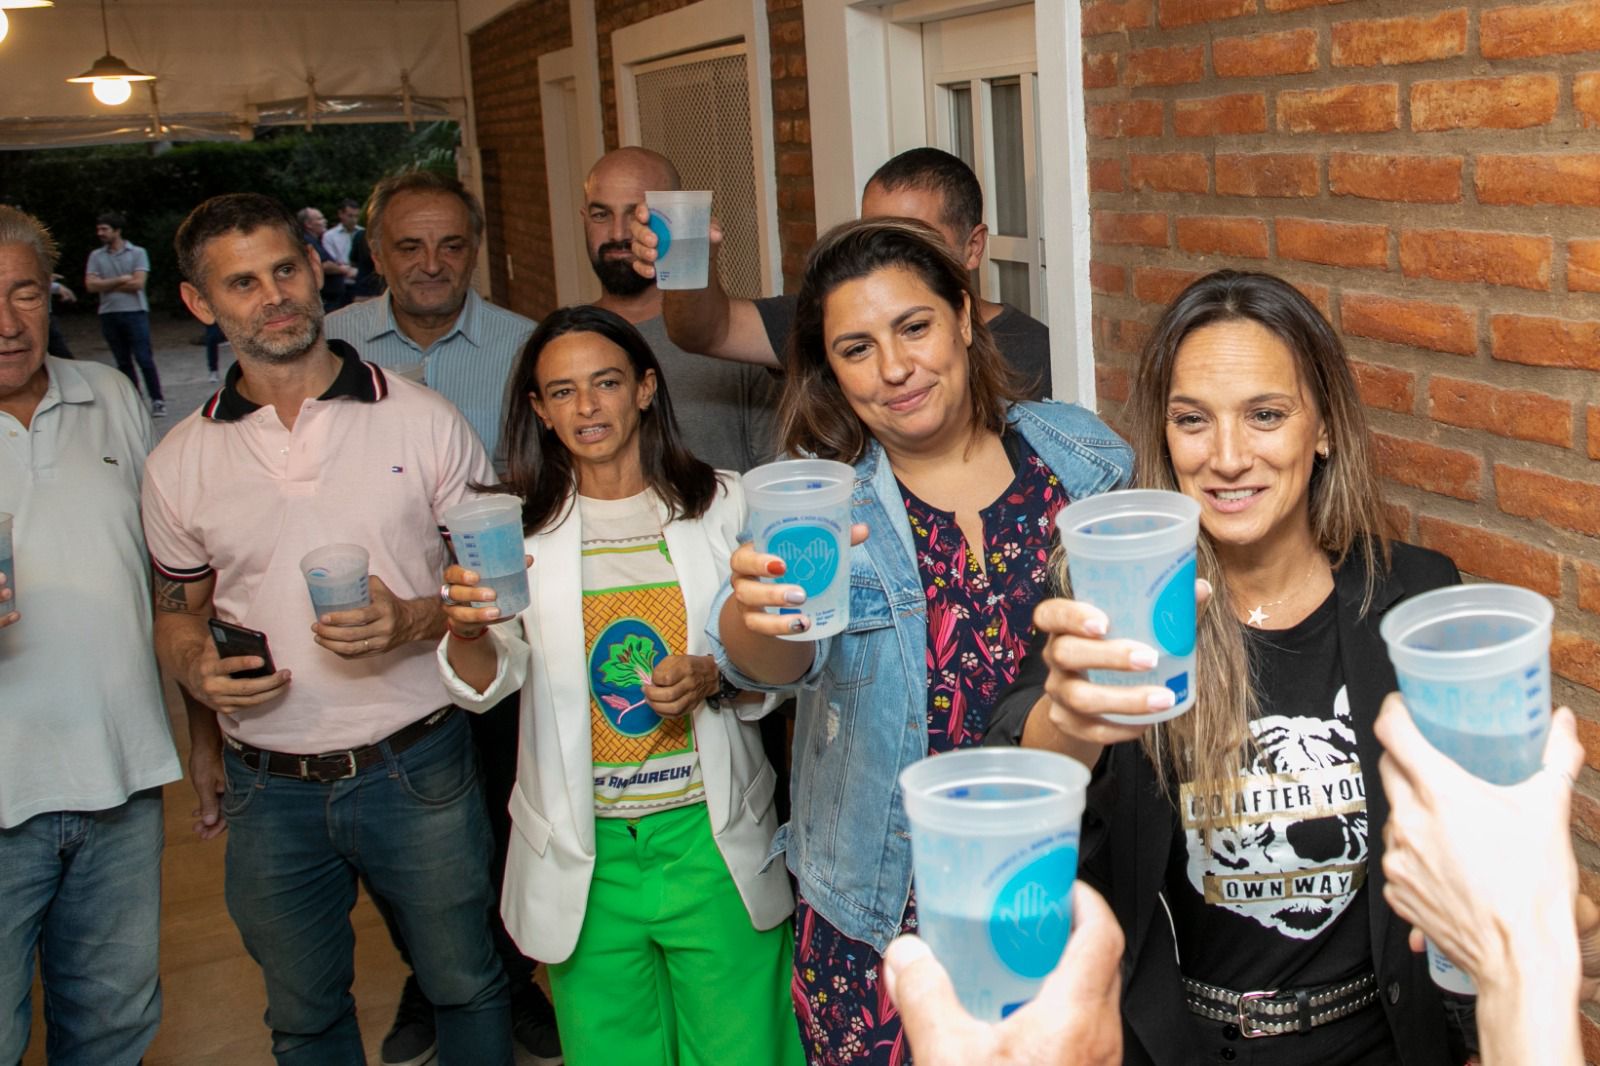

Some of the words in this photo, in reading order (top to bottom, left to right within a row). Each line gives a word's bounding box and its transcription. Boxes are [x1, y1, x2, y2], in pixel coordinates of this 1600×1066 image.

[1234, 784, 1311, 814] AFTER
[1226, 881, 1282, 898] OWN
[1295, 875, 1349, 893] WAY
